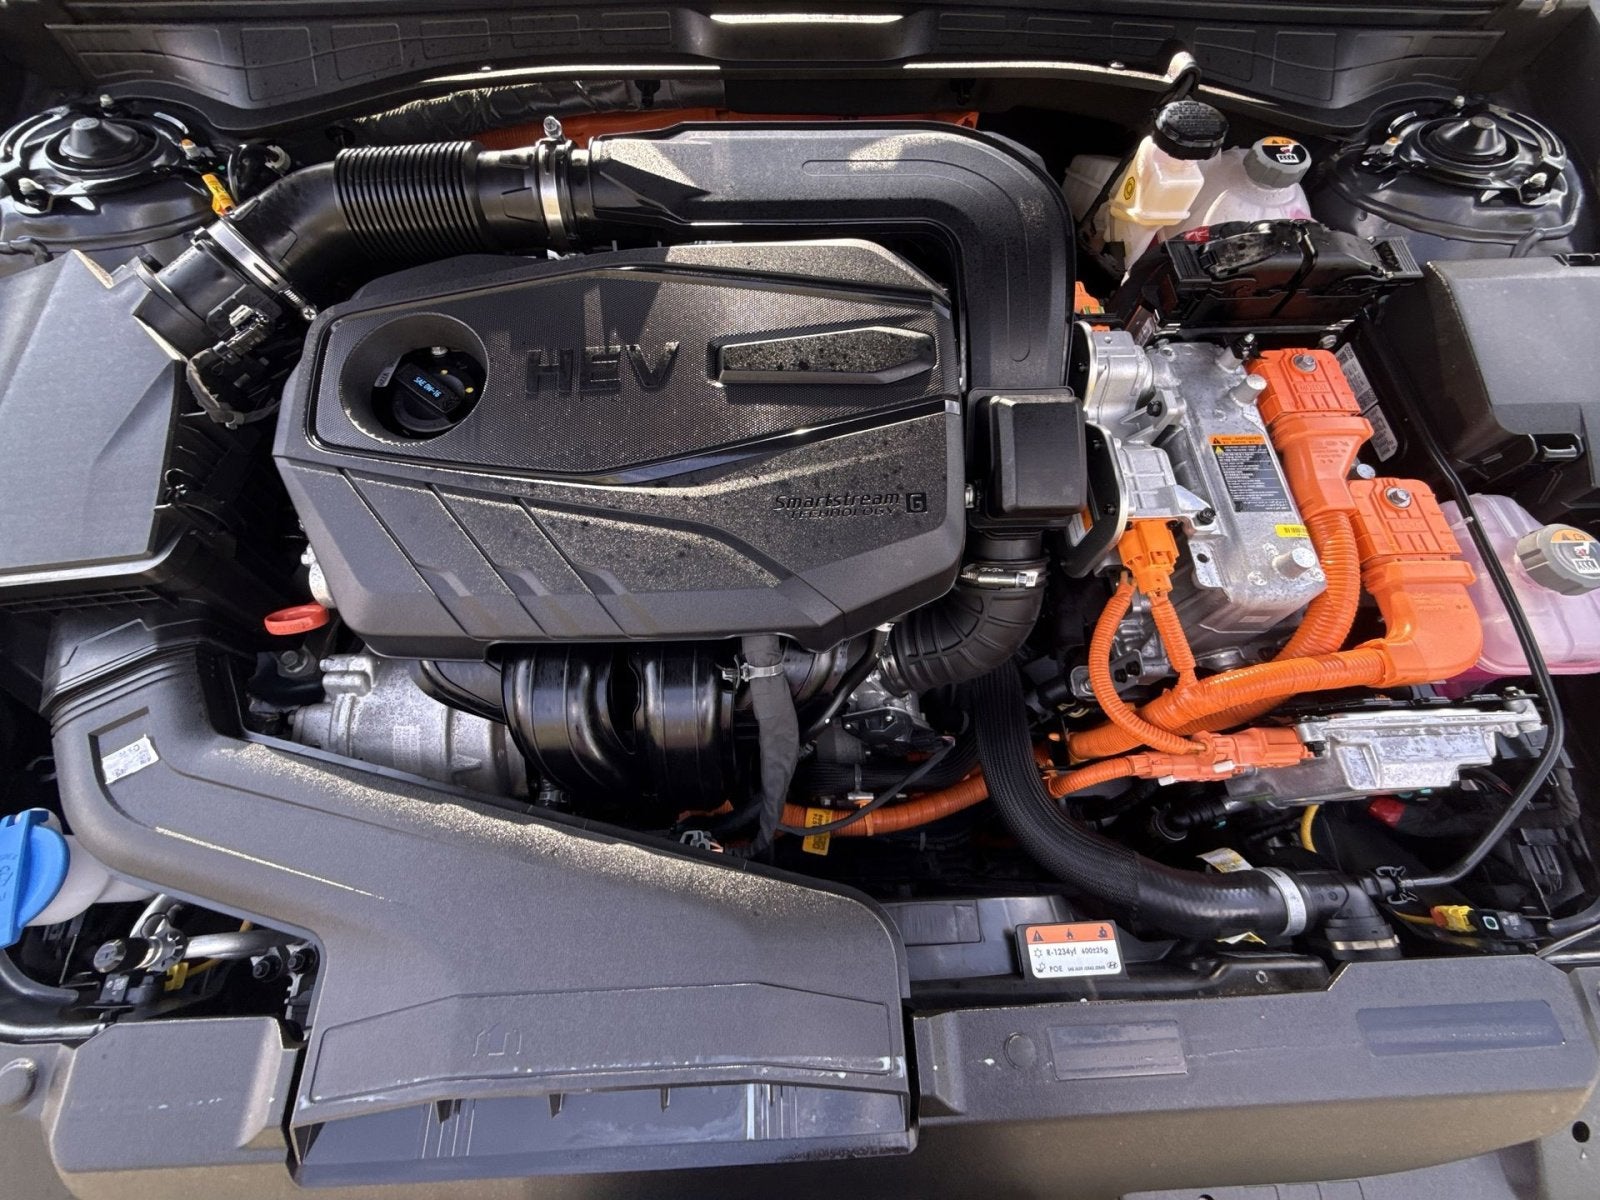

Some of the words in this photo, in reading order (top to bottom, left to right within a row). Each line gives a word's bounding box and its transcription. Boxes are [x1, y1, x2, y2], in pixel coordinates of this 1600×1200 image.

[525, 341, 680, 395] HEV
[774, 493, 900, 510] Smartstream
[907, 493, 926, 512] G
